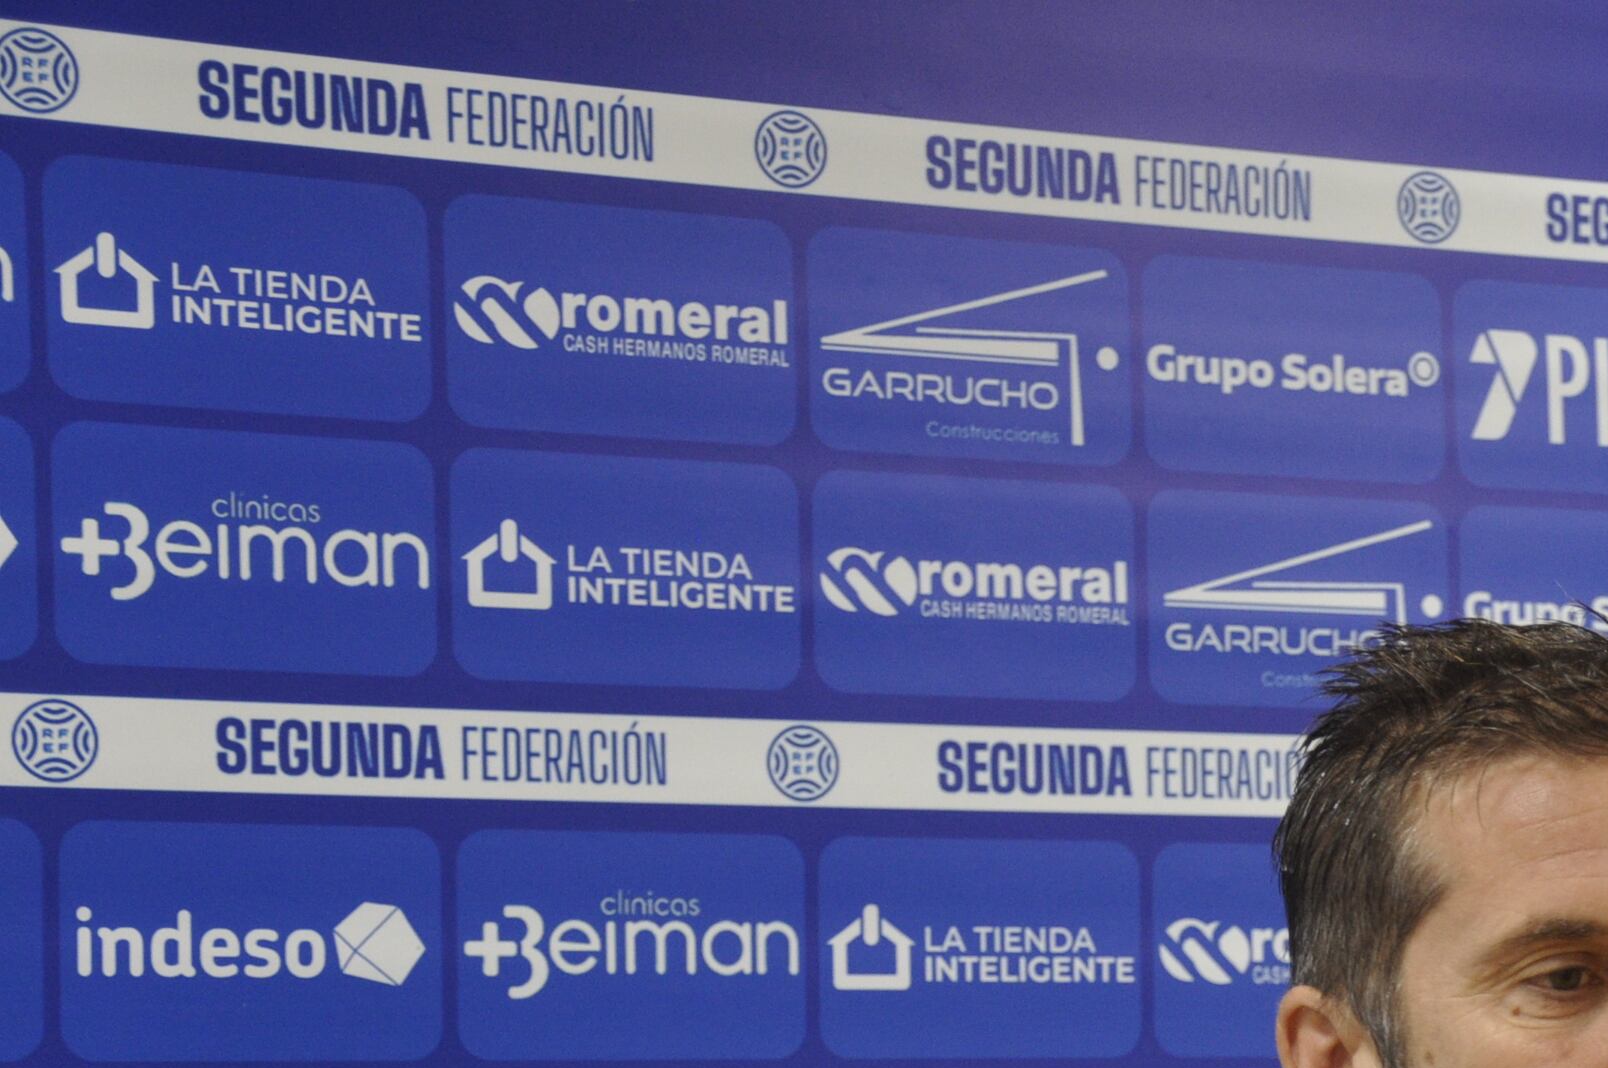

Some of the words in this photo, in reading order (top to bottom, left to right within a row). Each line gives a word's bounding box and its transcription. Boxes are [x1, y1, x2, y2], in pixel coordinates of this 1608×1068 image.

[198, 60, 430, 140] SEGUNDA
[447, 92, 653, 162] FEDERACIÓN
[926, 135, 1120, 204] SEGUNDA
[1135, 155, 1311, 221] FEDERACIÓN
[172, 263, 221, 293] LA
[230, 268, 375, 307] TIENDA
[173, 296, 421, 341] INTELIGENTE
[562, 293, 787, 344] romeral
[564, 334, 608, 353] CASH
[613, 338, 706, 361] HERMANOS
[712, 345, 789, 367] ROMERAL
[1147, 344, 1274, 394] Grupo
[1282, 354, 1408, 396] Solera
[823, 368, 1058, 410] GARRUCHO
[926, 422, 1059, 445] Construcciones
[568, 545, 612, 573] LA
[620, 548, 752, 580] TIENDA
[919, 561, 1127, 603] romeral
[568, 576, 794, 612] INTELIGENTE
[921, 599, 962, 617] CASH
[966, 602, 1052, 622] HERMANOS
[1056, 605, 1129, 625] ROMERAL
[216, 717, 445, 779] SEGUNDA
[462, 722, 666, 785] FEDERACIÓN
[938, 740, 1131, 796] SEGUNDA
[1146, 746, 1300, 800] FEDERACI
[76, 907, 326, 978] indeso
[925, 927, 960, 952] LA
[973, 927, 1096, 953] TIENDA
[925, 956, 1134, 983] INTELIGENTE
